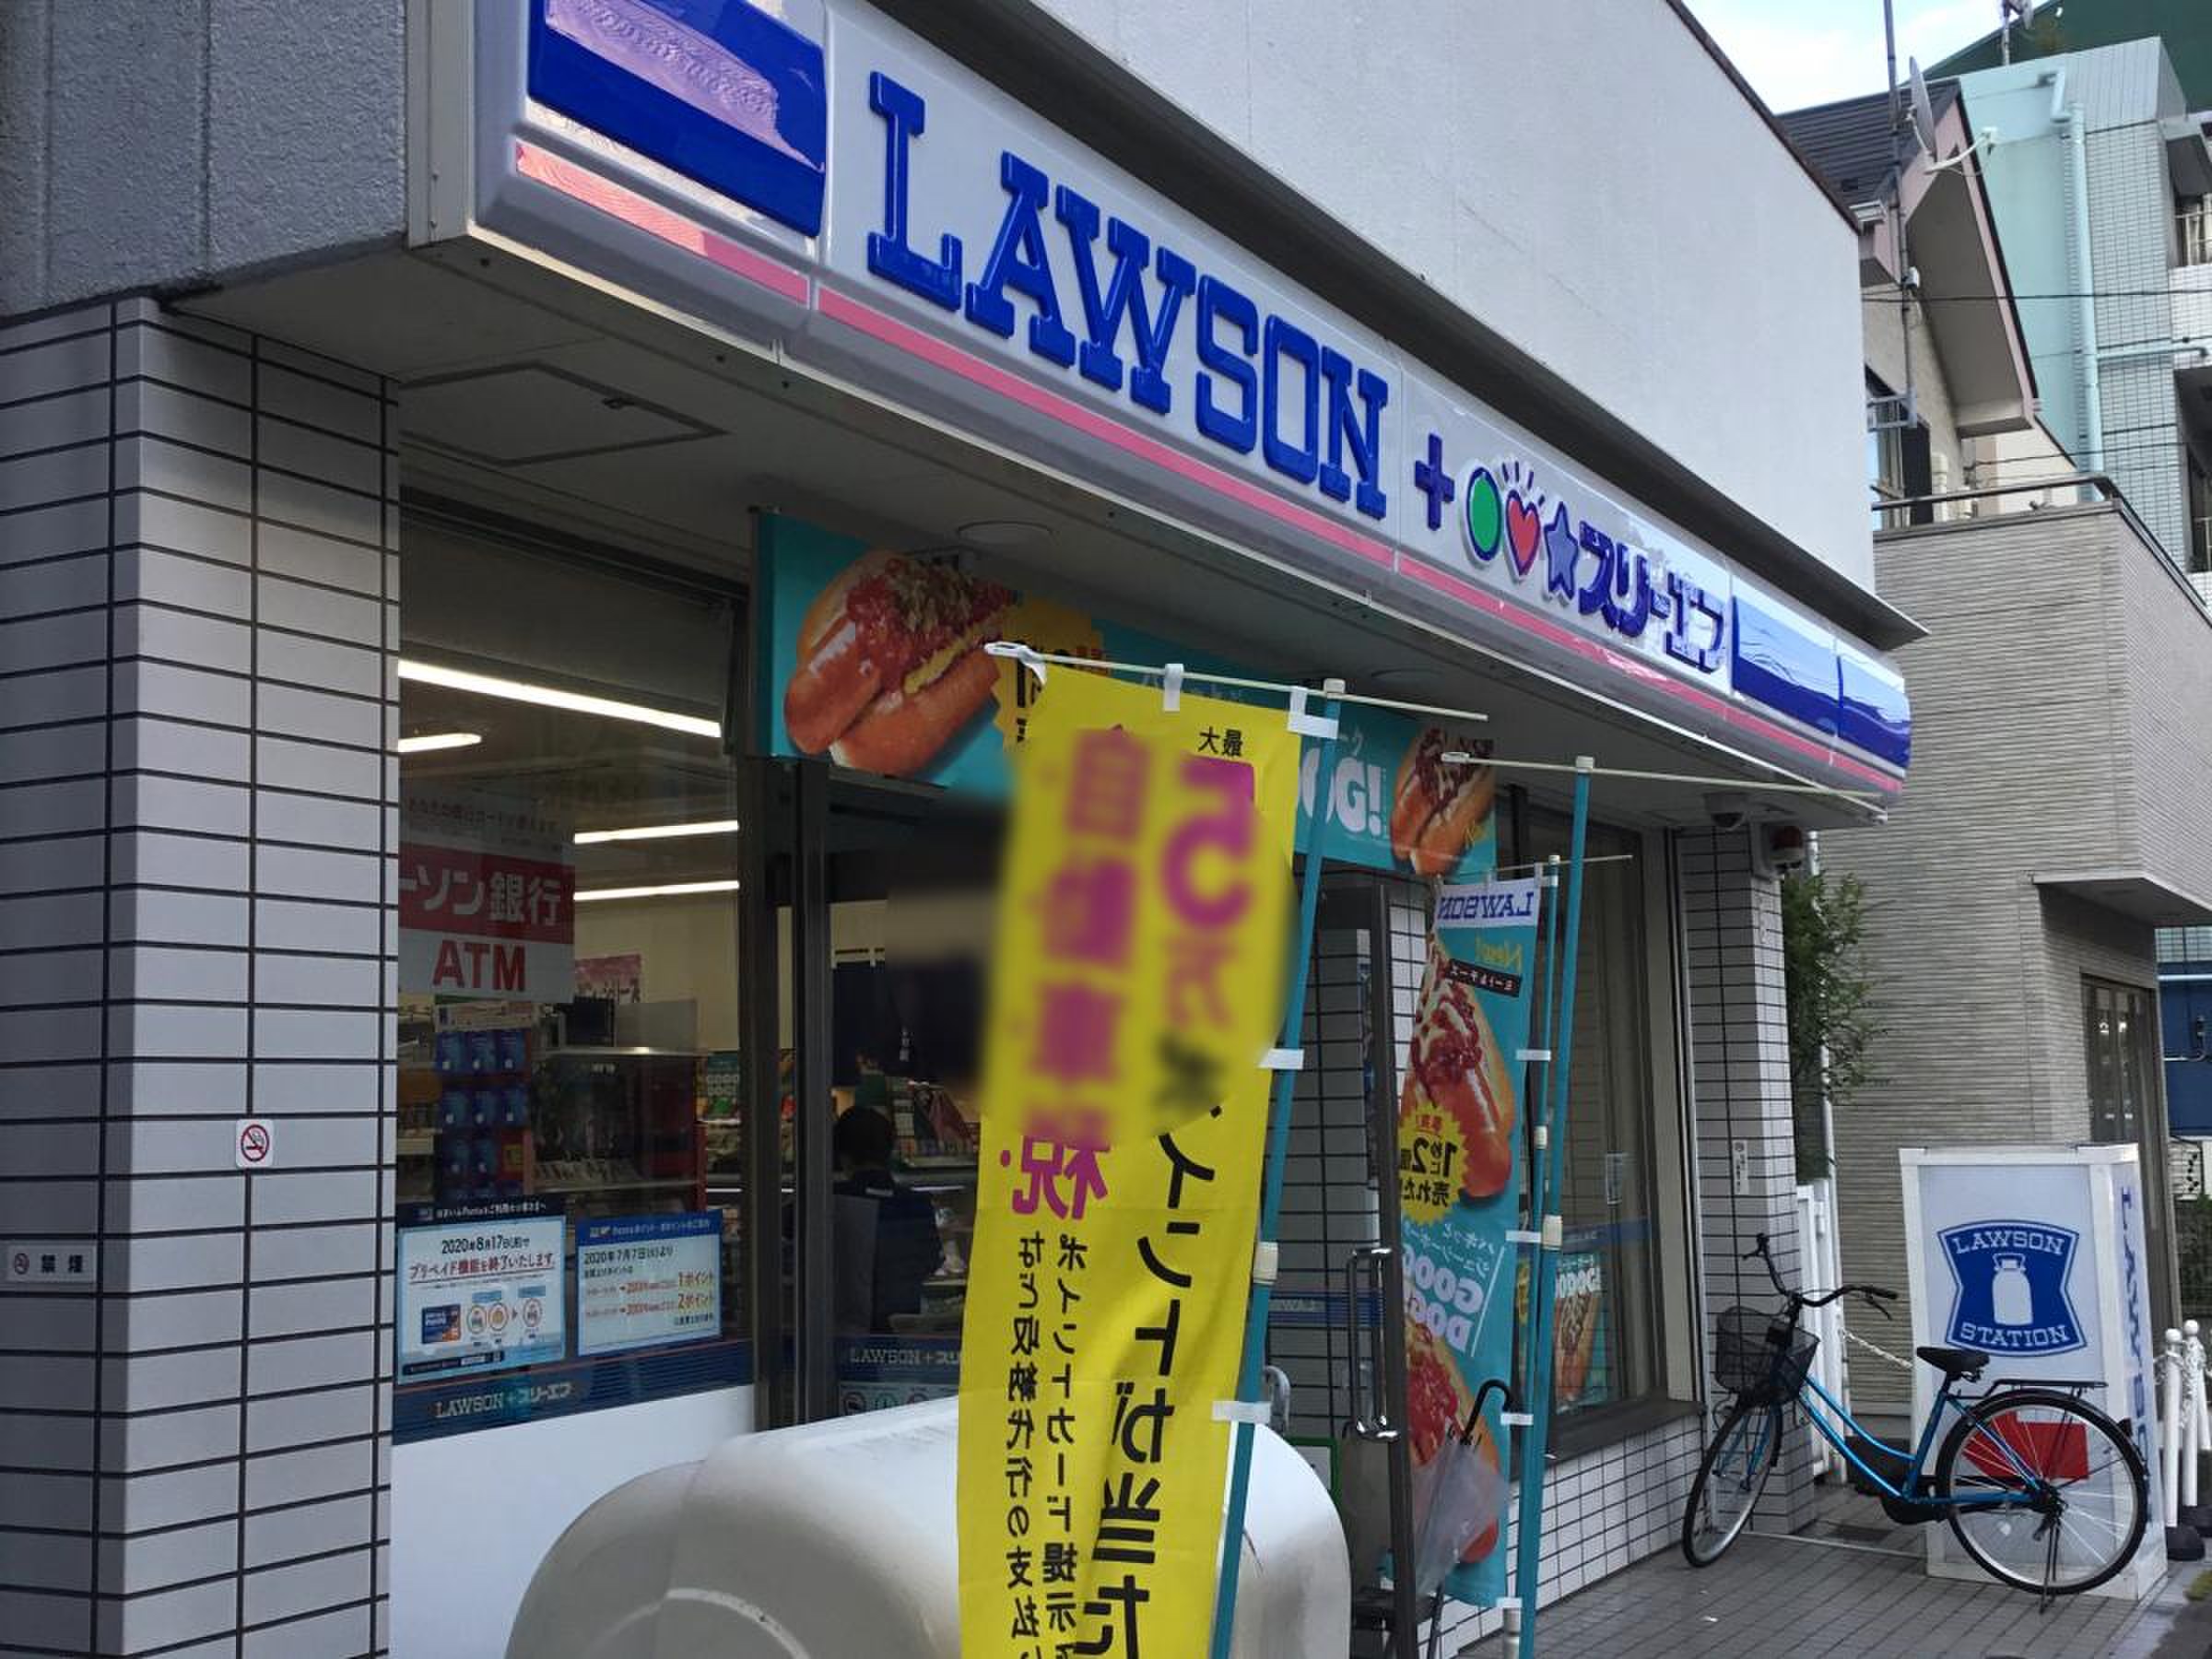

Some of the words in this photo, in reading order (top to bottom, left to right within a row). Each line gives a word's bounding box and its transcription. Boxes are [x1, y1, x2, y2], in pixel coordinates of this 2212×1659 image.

[866, 70, 1388, 521] LAWSON
[1578, 519, 1726, 675] スリーエフ
[432, 939, 526, 992] ATM
[1951, 1230, 2065, 1257] LAWSON
[41, 1253, 84, 1274] 禁煙
[1959, 1323, 2071, 1348] STATION
[850, 1347, 921, 1366] LAWSON
[433, 1391, 504, 1419] LAWSON
